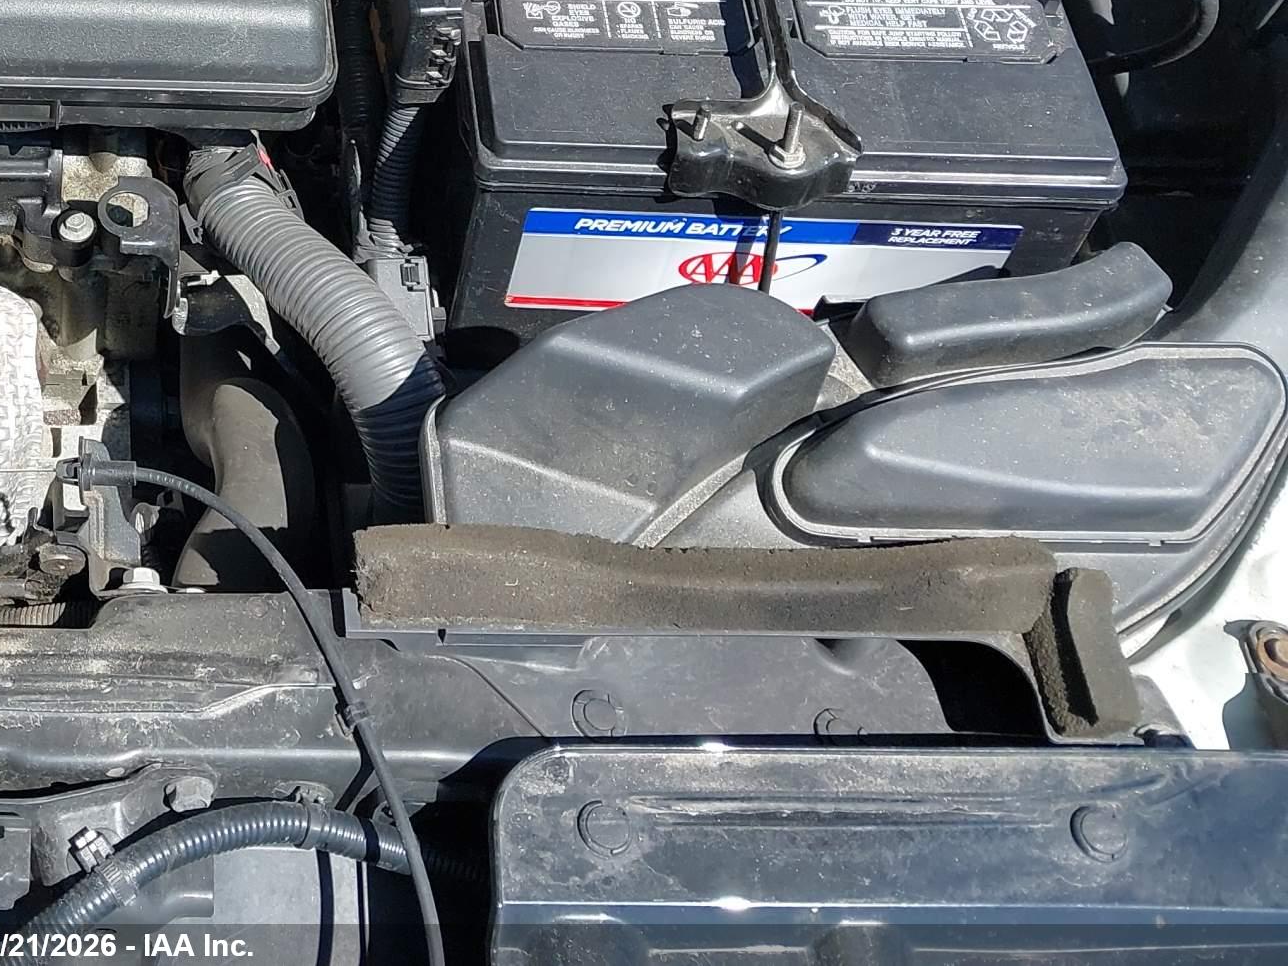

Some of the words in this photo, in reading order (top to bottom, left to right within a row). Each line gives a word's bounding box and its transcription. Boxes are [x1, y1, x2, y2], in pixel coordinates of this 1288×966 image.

[894, 8, 946, 16] IMMEDIATELY
[574, 218, 687, 234] PREMIUM
[905, 228, 942, 237] YEAR
[942, 230, 982, 238] FREE
[887, 236, 977, 245] REPLACEMENT
